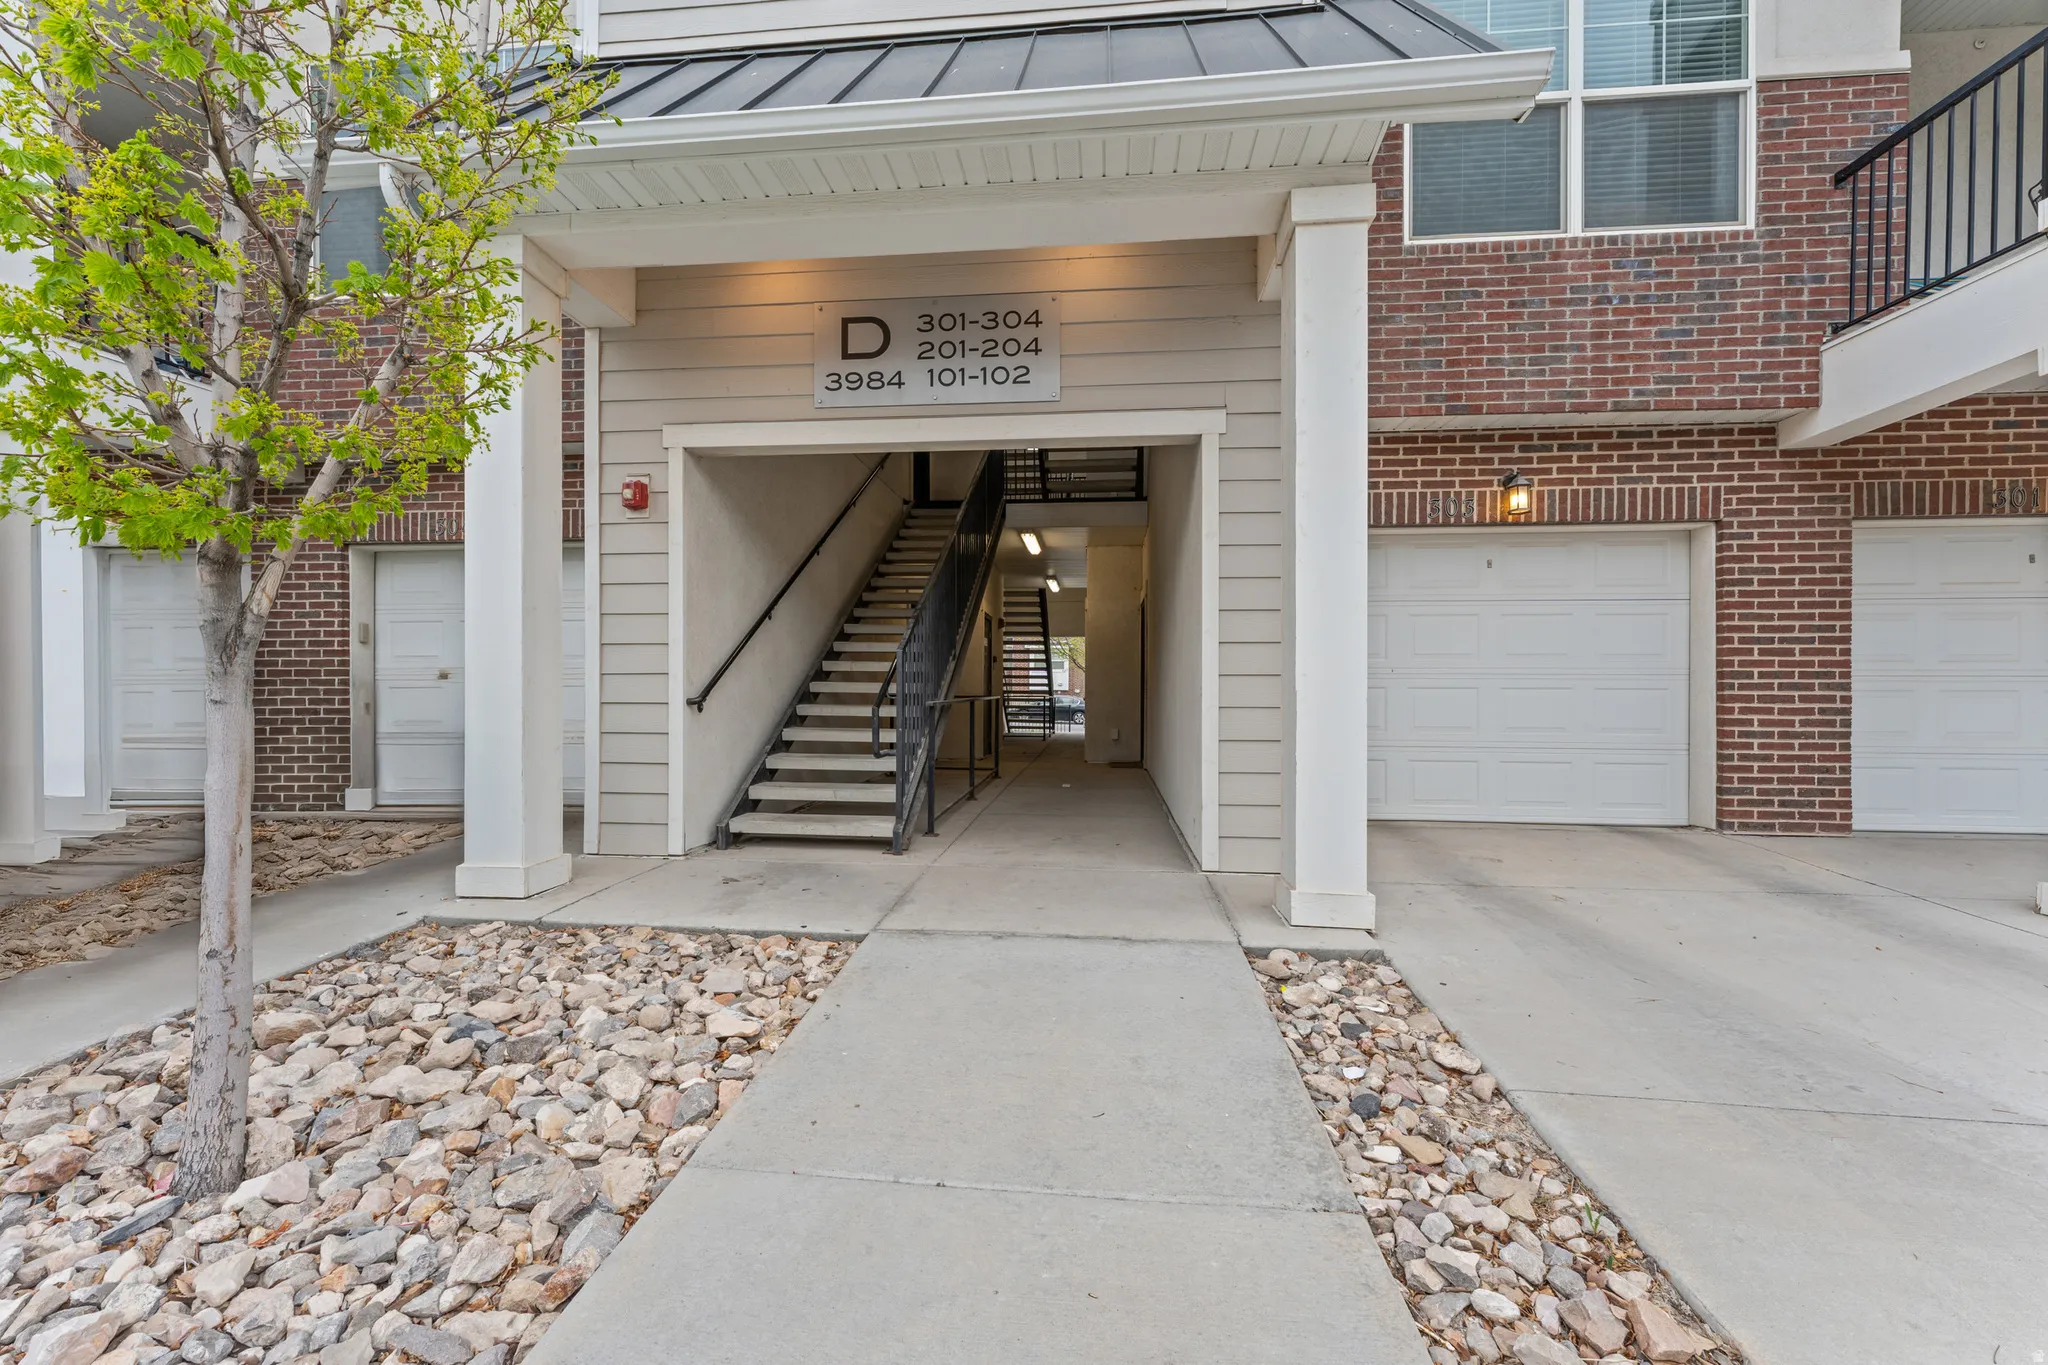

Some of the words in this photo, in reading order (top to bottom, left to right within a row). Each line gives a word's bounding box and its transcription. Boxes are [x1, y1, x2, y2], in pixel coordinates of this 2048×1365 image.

[916, 309, 1043, 333] 301-304
[841, 316, 891, 360] D
[917, 337, 1042, 360] 201-204
[825, 370, 905, 392] 3984
[927, 365, 1031, 387] 101-102
[1428, 496, 1475, 519] 303
[1992, 486, 2040, 509] 301
[435, 517, 465, 537] 30
